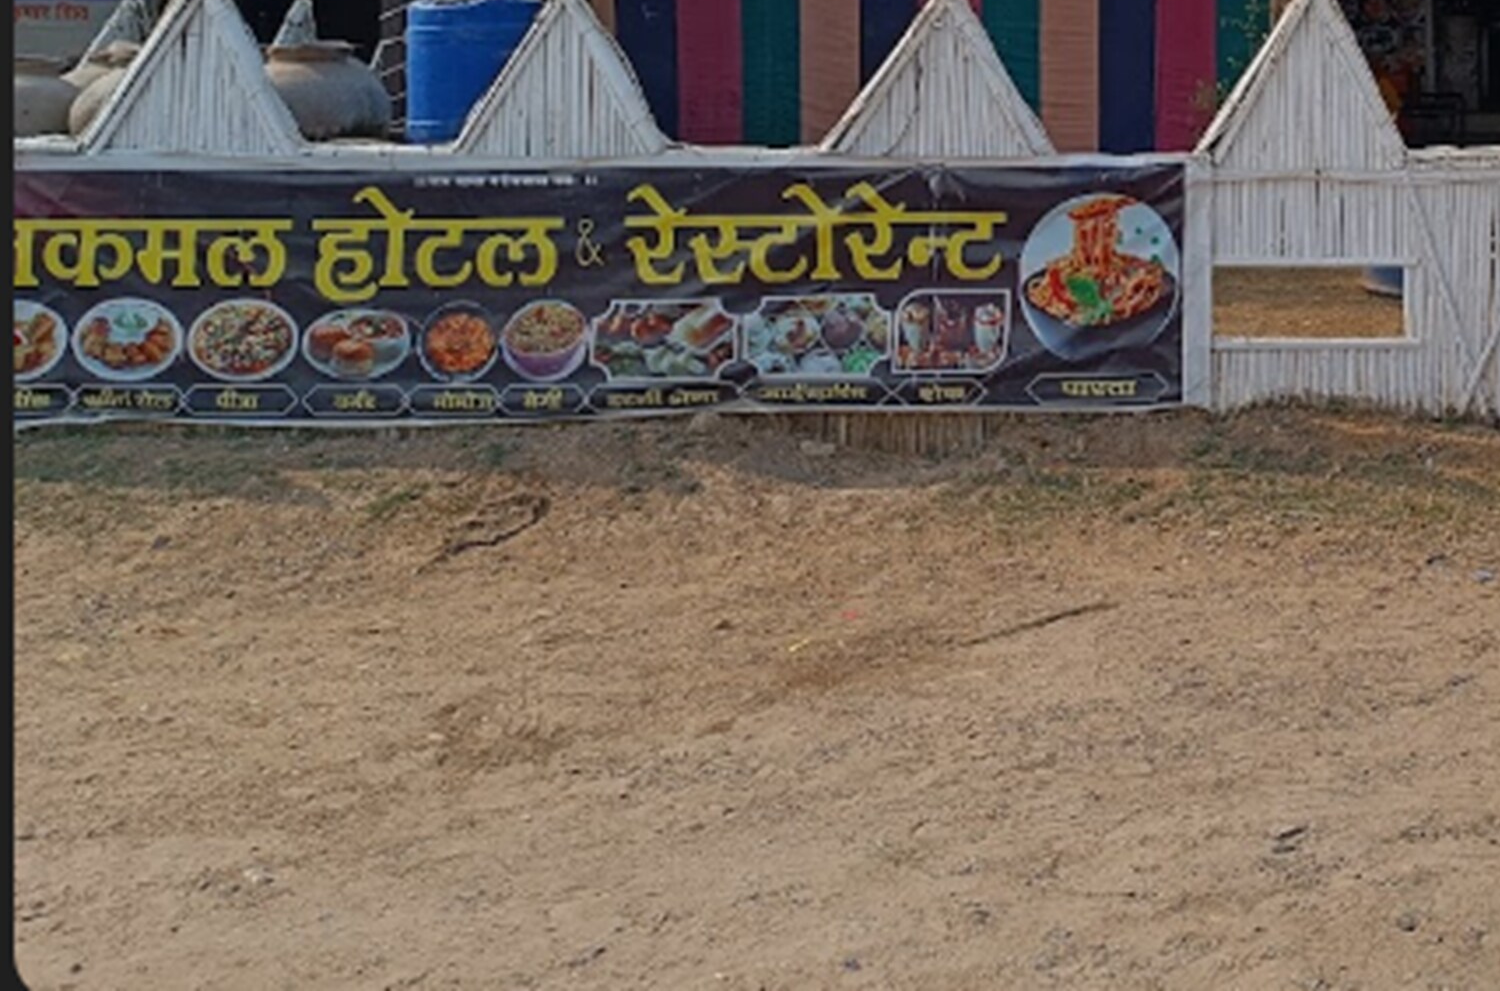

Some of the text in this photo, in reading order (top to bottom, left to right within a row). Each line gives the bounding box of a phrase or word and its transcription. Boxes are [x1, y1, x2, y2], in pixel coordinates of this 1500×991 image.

[312, 186, 565, 304] होटल
[575, 218, 604, 267] &
[625, 182, 1007, 285] रेस्टोरेन्ट
